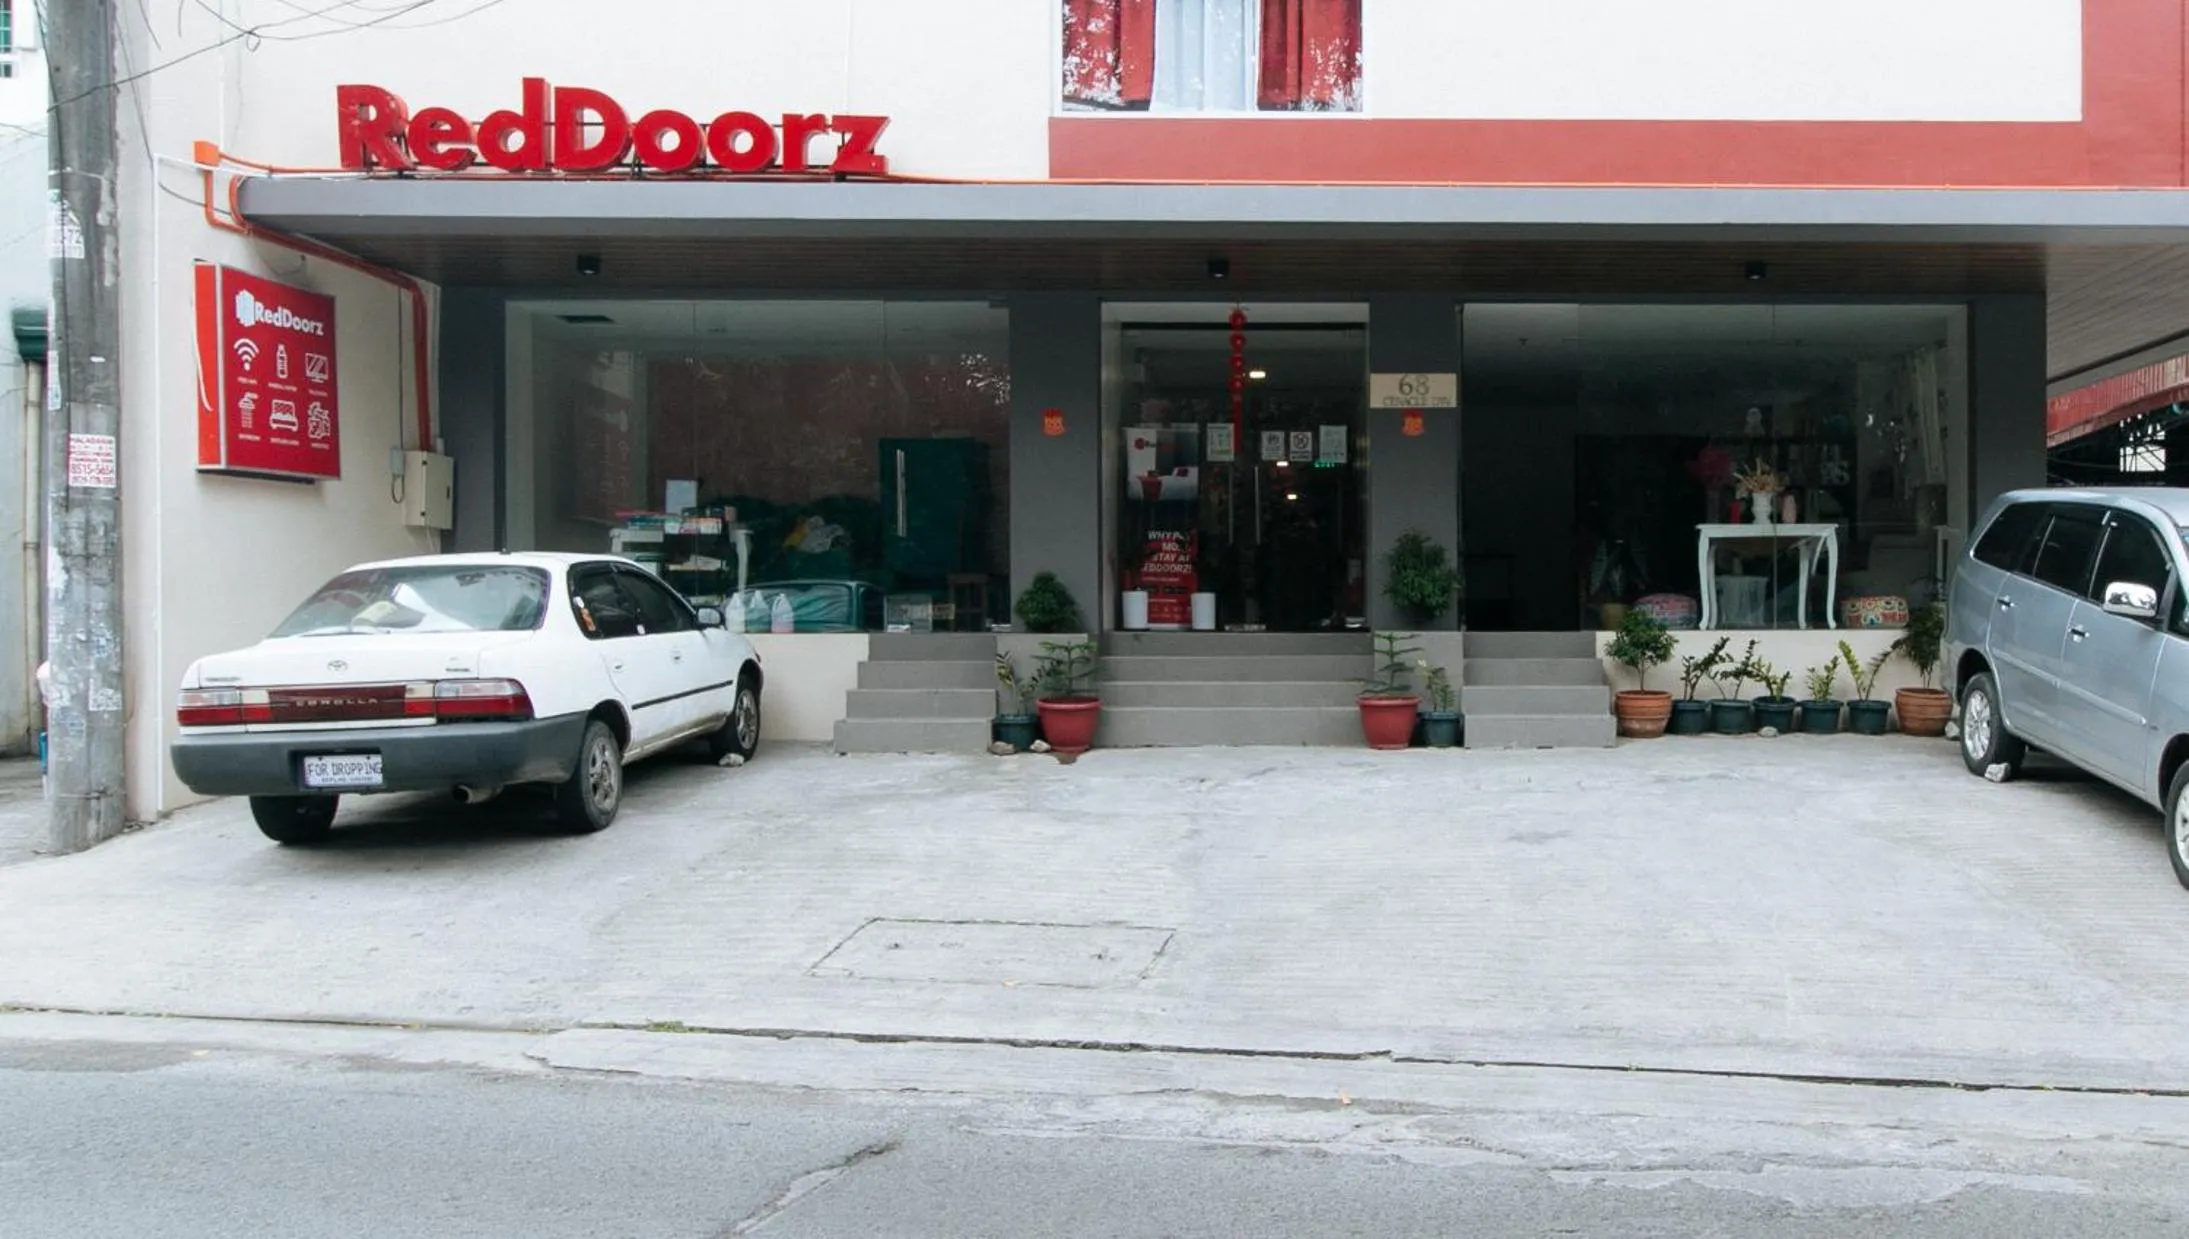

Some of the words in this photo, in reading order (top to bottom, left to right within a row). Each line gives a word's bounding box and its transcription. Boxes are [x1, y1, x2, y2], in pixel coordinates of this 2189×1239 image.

[337, 77, 890, 176] RedDoorz
[254, 301, 325, 336] RedDoorz
[1399, 373, 1430, 396] 68
[307, 762, 329, 776] FOR
